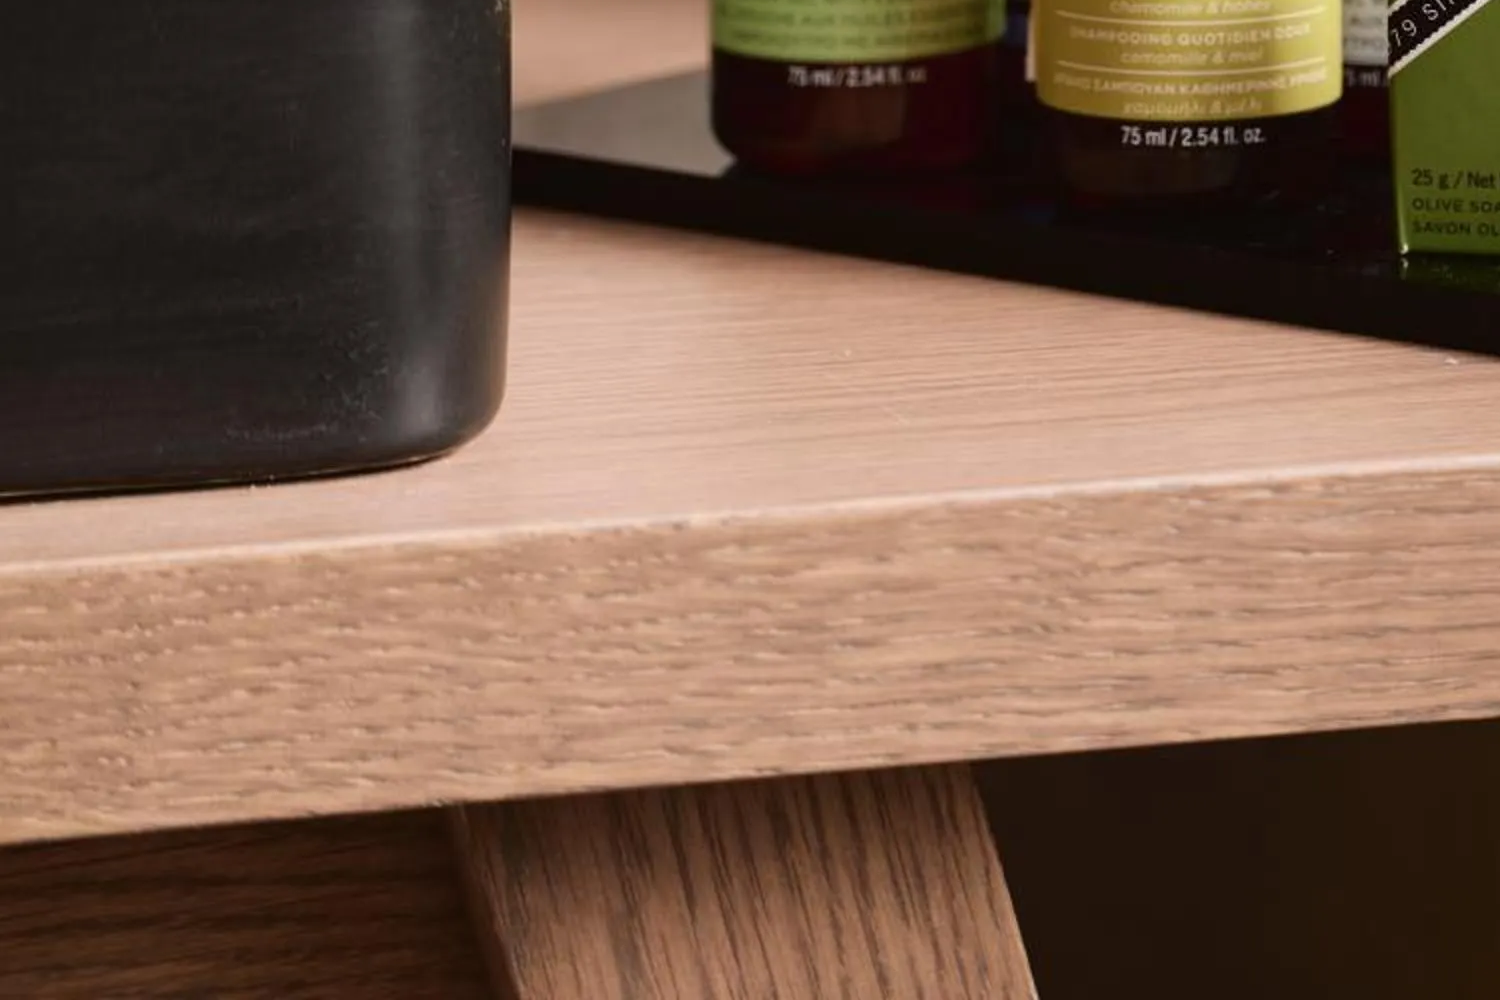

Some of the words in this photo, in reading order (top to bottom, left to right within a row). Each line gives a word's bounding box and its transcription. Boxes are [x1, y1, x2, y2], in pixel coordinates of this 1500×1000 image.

[1177, 27, 1271, 46] QUOTIDIEN
[1120, 126, 1141, 146] 75
[1146, 125, 1166, 146] ml
[1181, 127, 1219, 147] 2.54
[1411, 168, 1433, 187] 25
[1438, 173, 1450, 191] g
[1467, 171, 1496, 190] Net
[1411, 197, 1463, 213] OLIVE
[1411, 221, 1471, 236] SAVON
